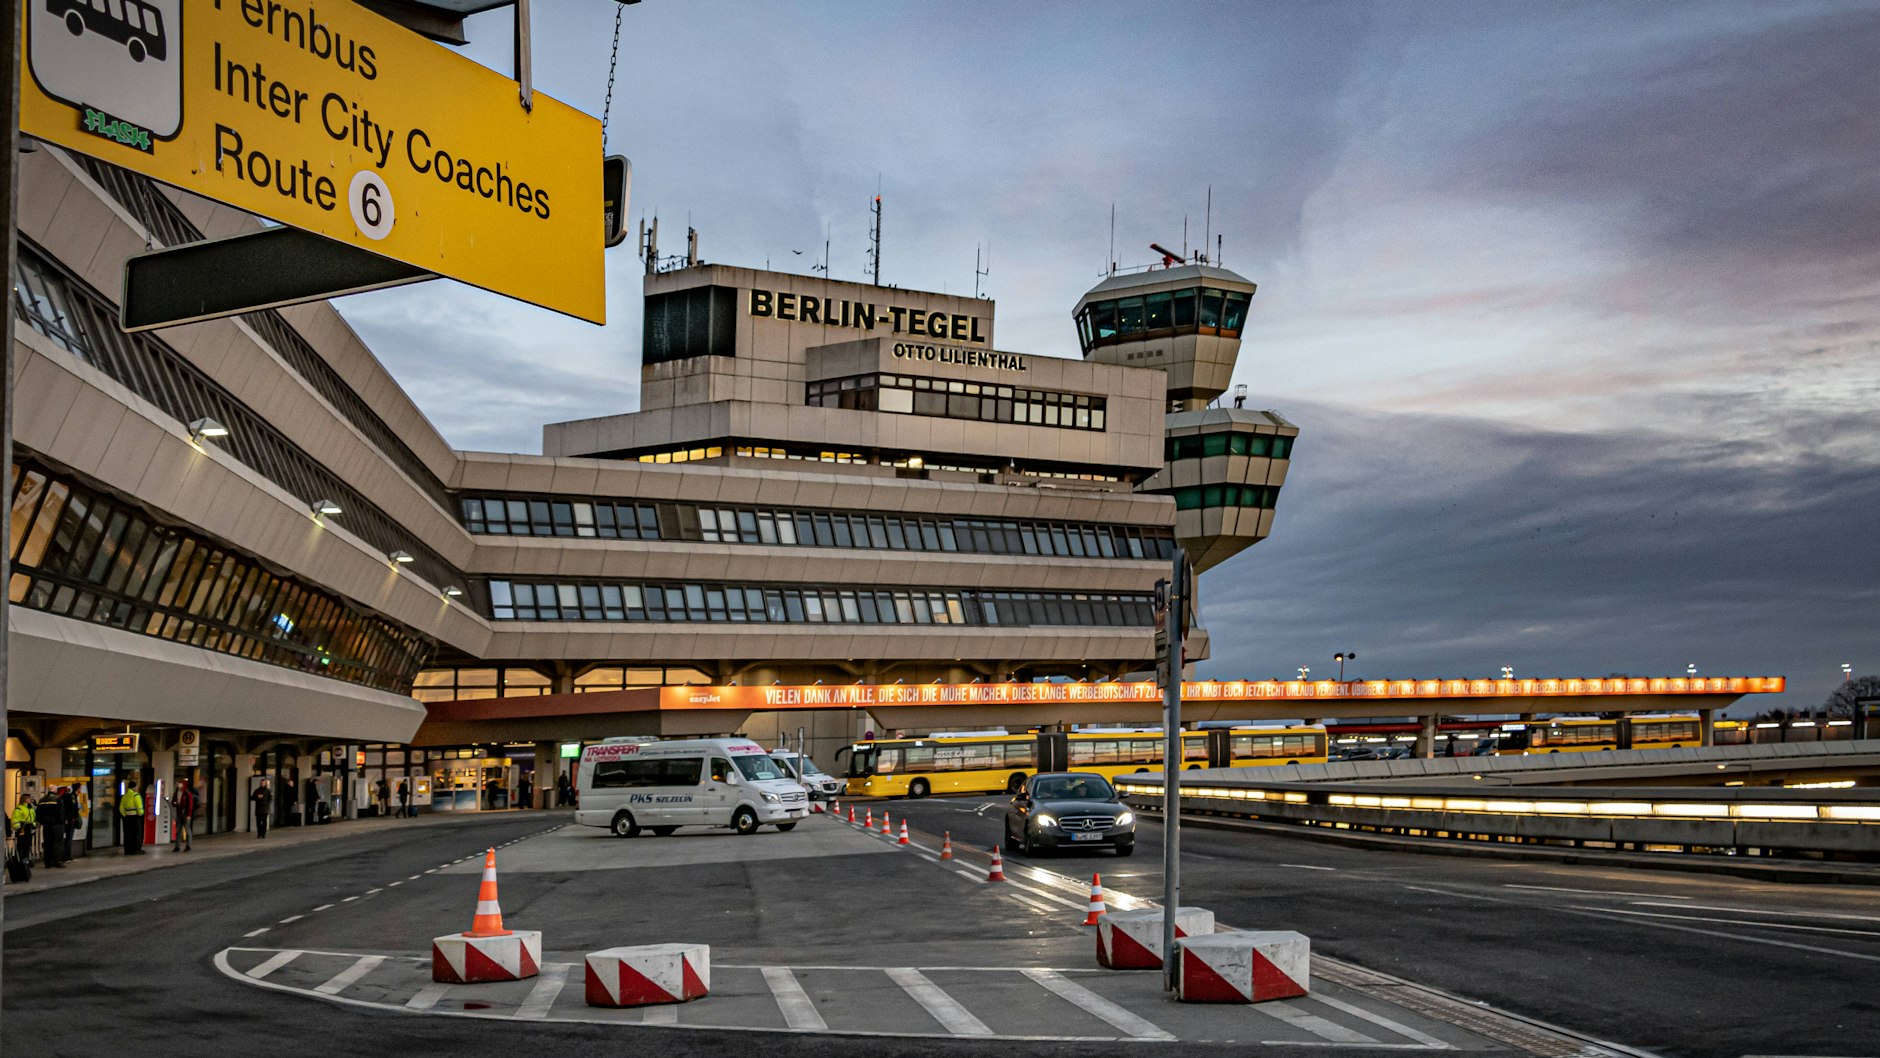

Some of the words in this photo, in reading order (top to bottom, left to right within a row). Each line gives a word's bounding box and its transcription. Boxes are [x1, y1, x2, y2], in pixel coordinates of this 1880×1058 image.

[214, 0, 377, 81] ernbus
[84, 111, 151, 150] FLASH
[214, 41, 309, 123] Inter
[321, 93, 394, 168] City
[406, 128, 551, 220] Coaches
[214, 123, 337, 211] Route
[360, 182, 382, 227] 6
[749, 289, 985, 343] BERLIN-TEGEL
[892, 342, 936, 362] OTTO
[938, 348, 1027, 372] LILIENTHAL
[689, 695, 721, 704] easyJet
[765, 689, 801, 704] VIELEN
[804, 689, 831, 704] DANK
[833, 689, 847, 703] AN
[850, 688, 876, 704] ALLE,
[879, 688, 894, 703] DIE
[897, 688, 919, 702] SICH
[922, 687, 938, 702] DIE
[969, 687, 1010, 703] MACHEN,
[1012, 687, 1037, 701] DIESE
[1039, 686, 1066, 701] LANGE
[1069, 686, 1144, 700] WERBEBOTSCHAFT
[1146, 685, 1156, 698] ZU
[1187, 684, 1200, 698] IHR
[1202, 684, 1223, 697] HABT
[1224, 684, 1244, 697] EUCH
[1245, 684, 1265, 697] JETZT
[1266, 684, 1285, 697] ECHT
[1286, 684, 1315, 697] URLAUB
[1388, 683, 1400, 696] MIT
[630, 793, 653, 803] PKS
[656, 794, 693, 803] SZCZECIN
